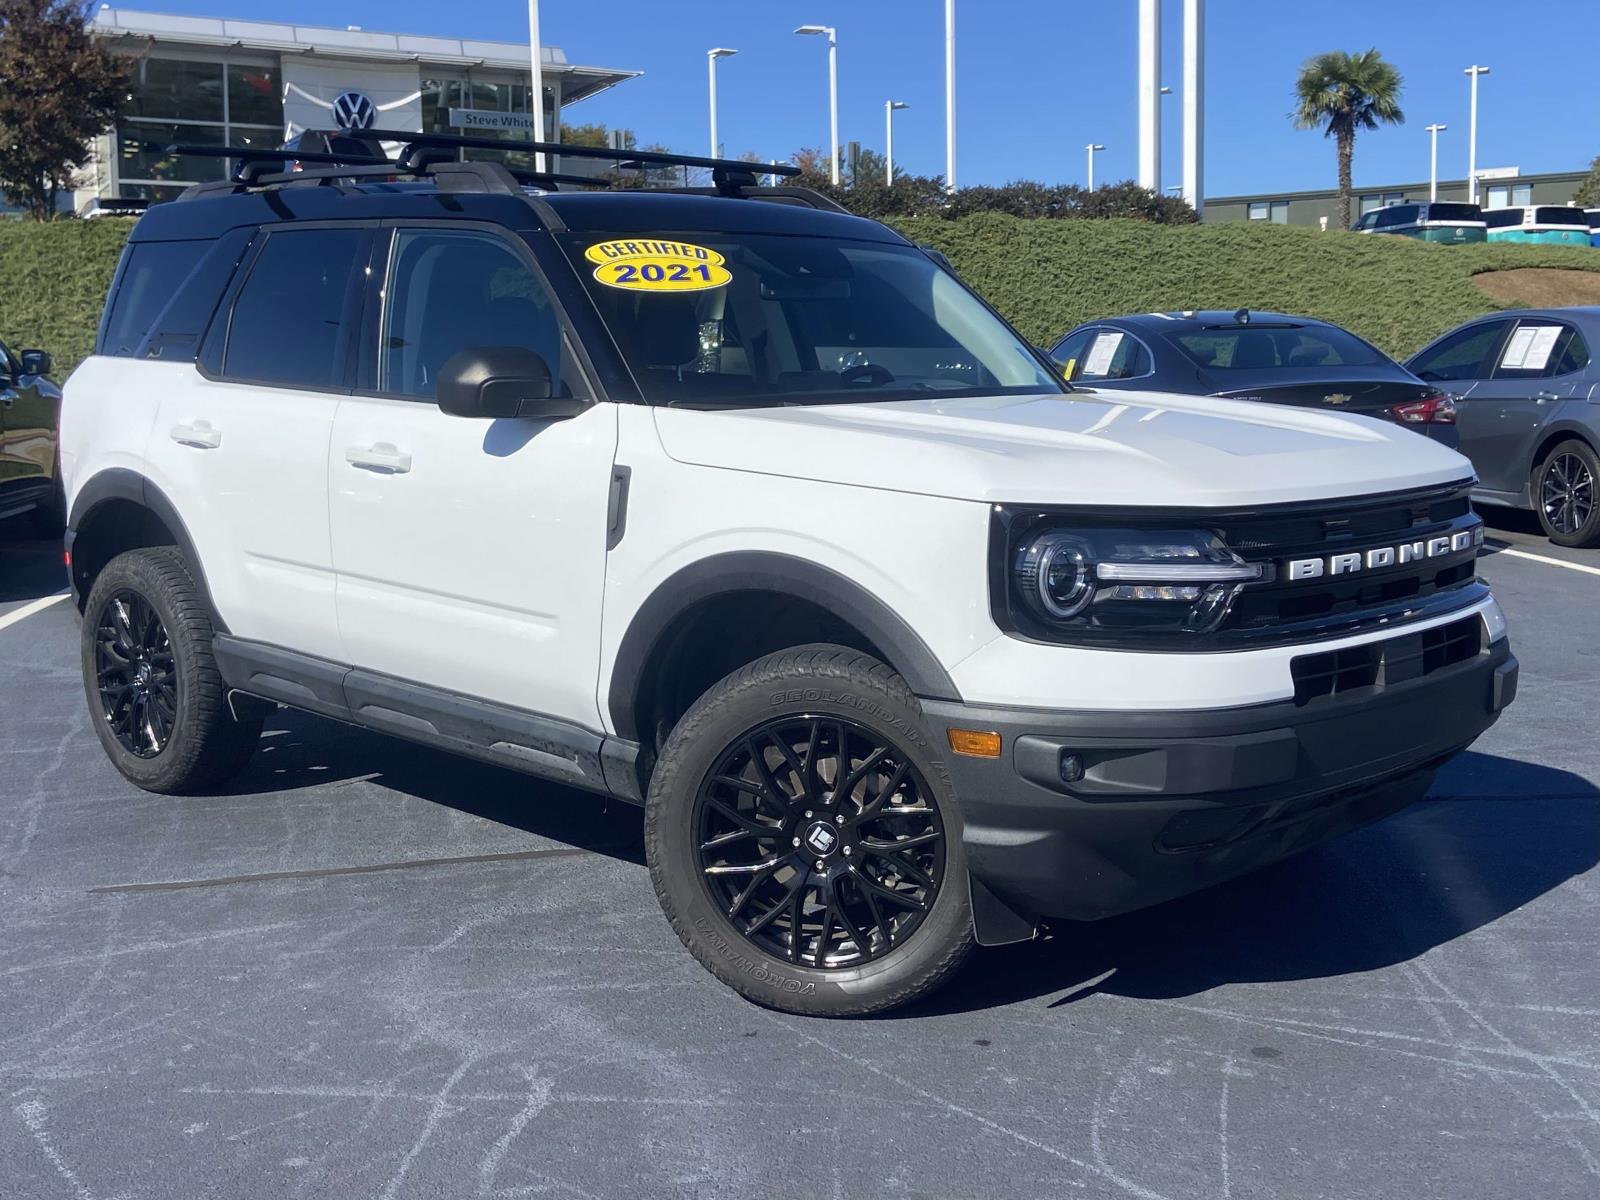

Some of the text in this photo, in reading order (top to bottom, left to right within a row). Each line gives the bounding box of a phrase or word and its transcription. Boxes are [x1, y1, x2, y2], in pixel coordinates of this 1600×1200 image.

[465, 114, 498, 126] Steve
[600, 241, 709, 260] CERTIFIED
[614, 263, 712, 284] 2021
[1289, 531, 1471, 580] BRONCO
[769, 687, 928, 748] GEOLANDAR
[695, 916, 816, 996] YOKOHAMA
